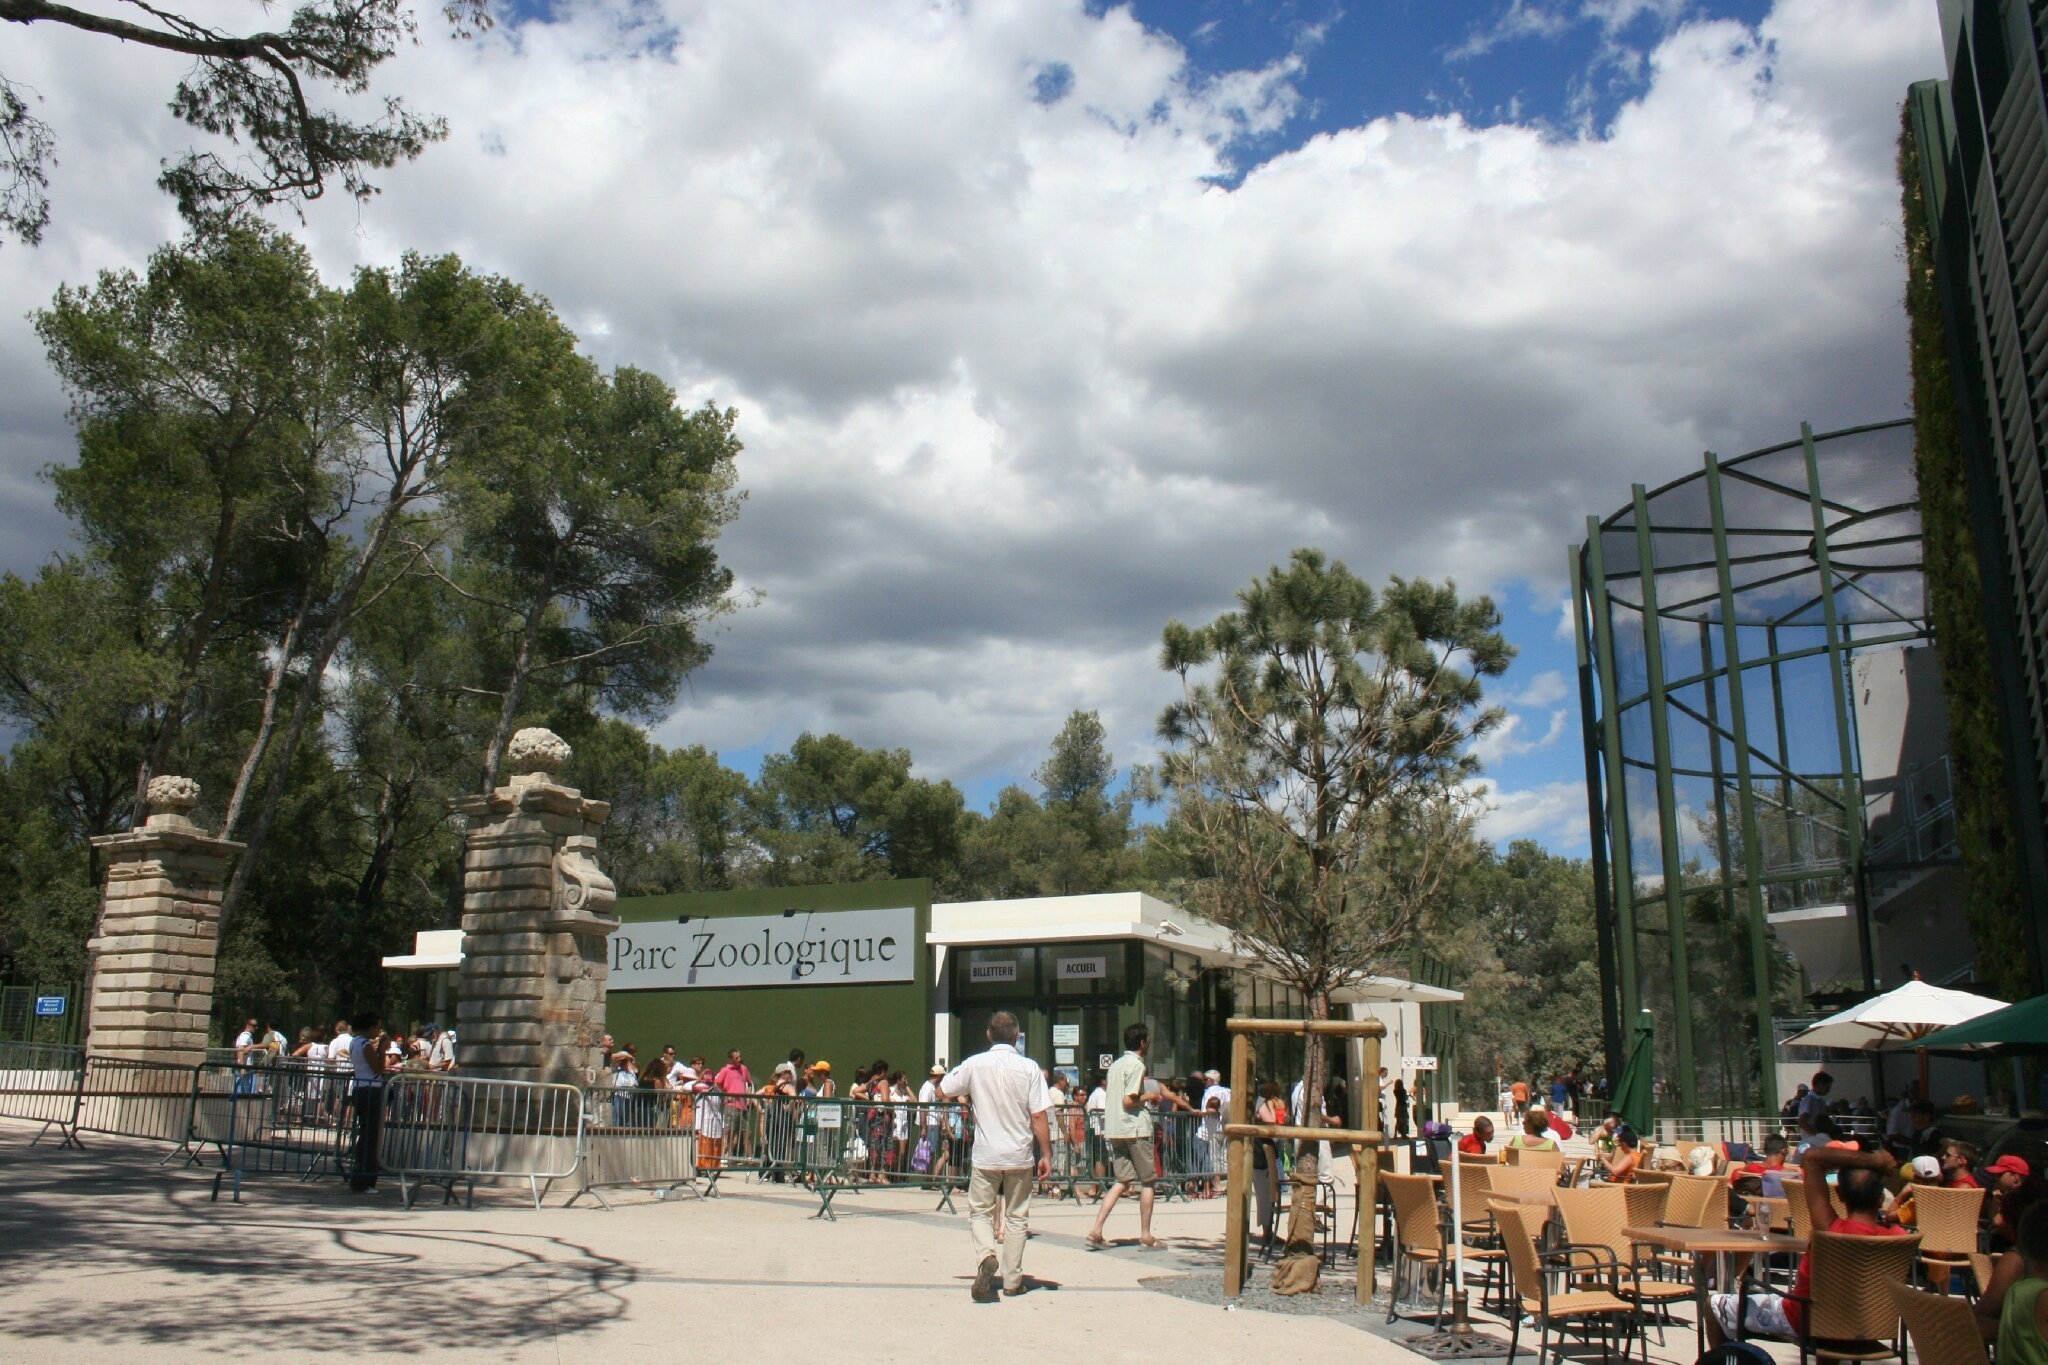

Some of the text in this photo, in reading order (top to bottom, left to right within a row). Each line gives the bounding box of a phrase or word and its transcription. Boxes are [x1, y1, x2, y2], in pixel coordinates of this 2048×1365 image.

[612, 928, 896, 977] Parc Zoologique
[973, 966, 1014, 977] BILLETTERIE
[1066, 962, 1097, 974] ACCUEIL
